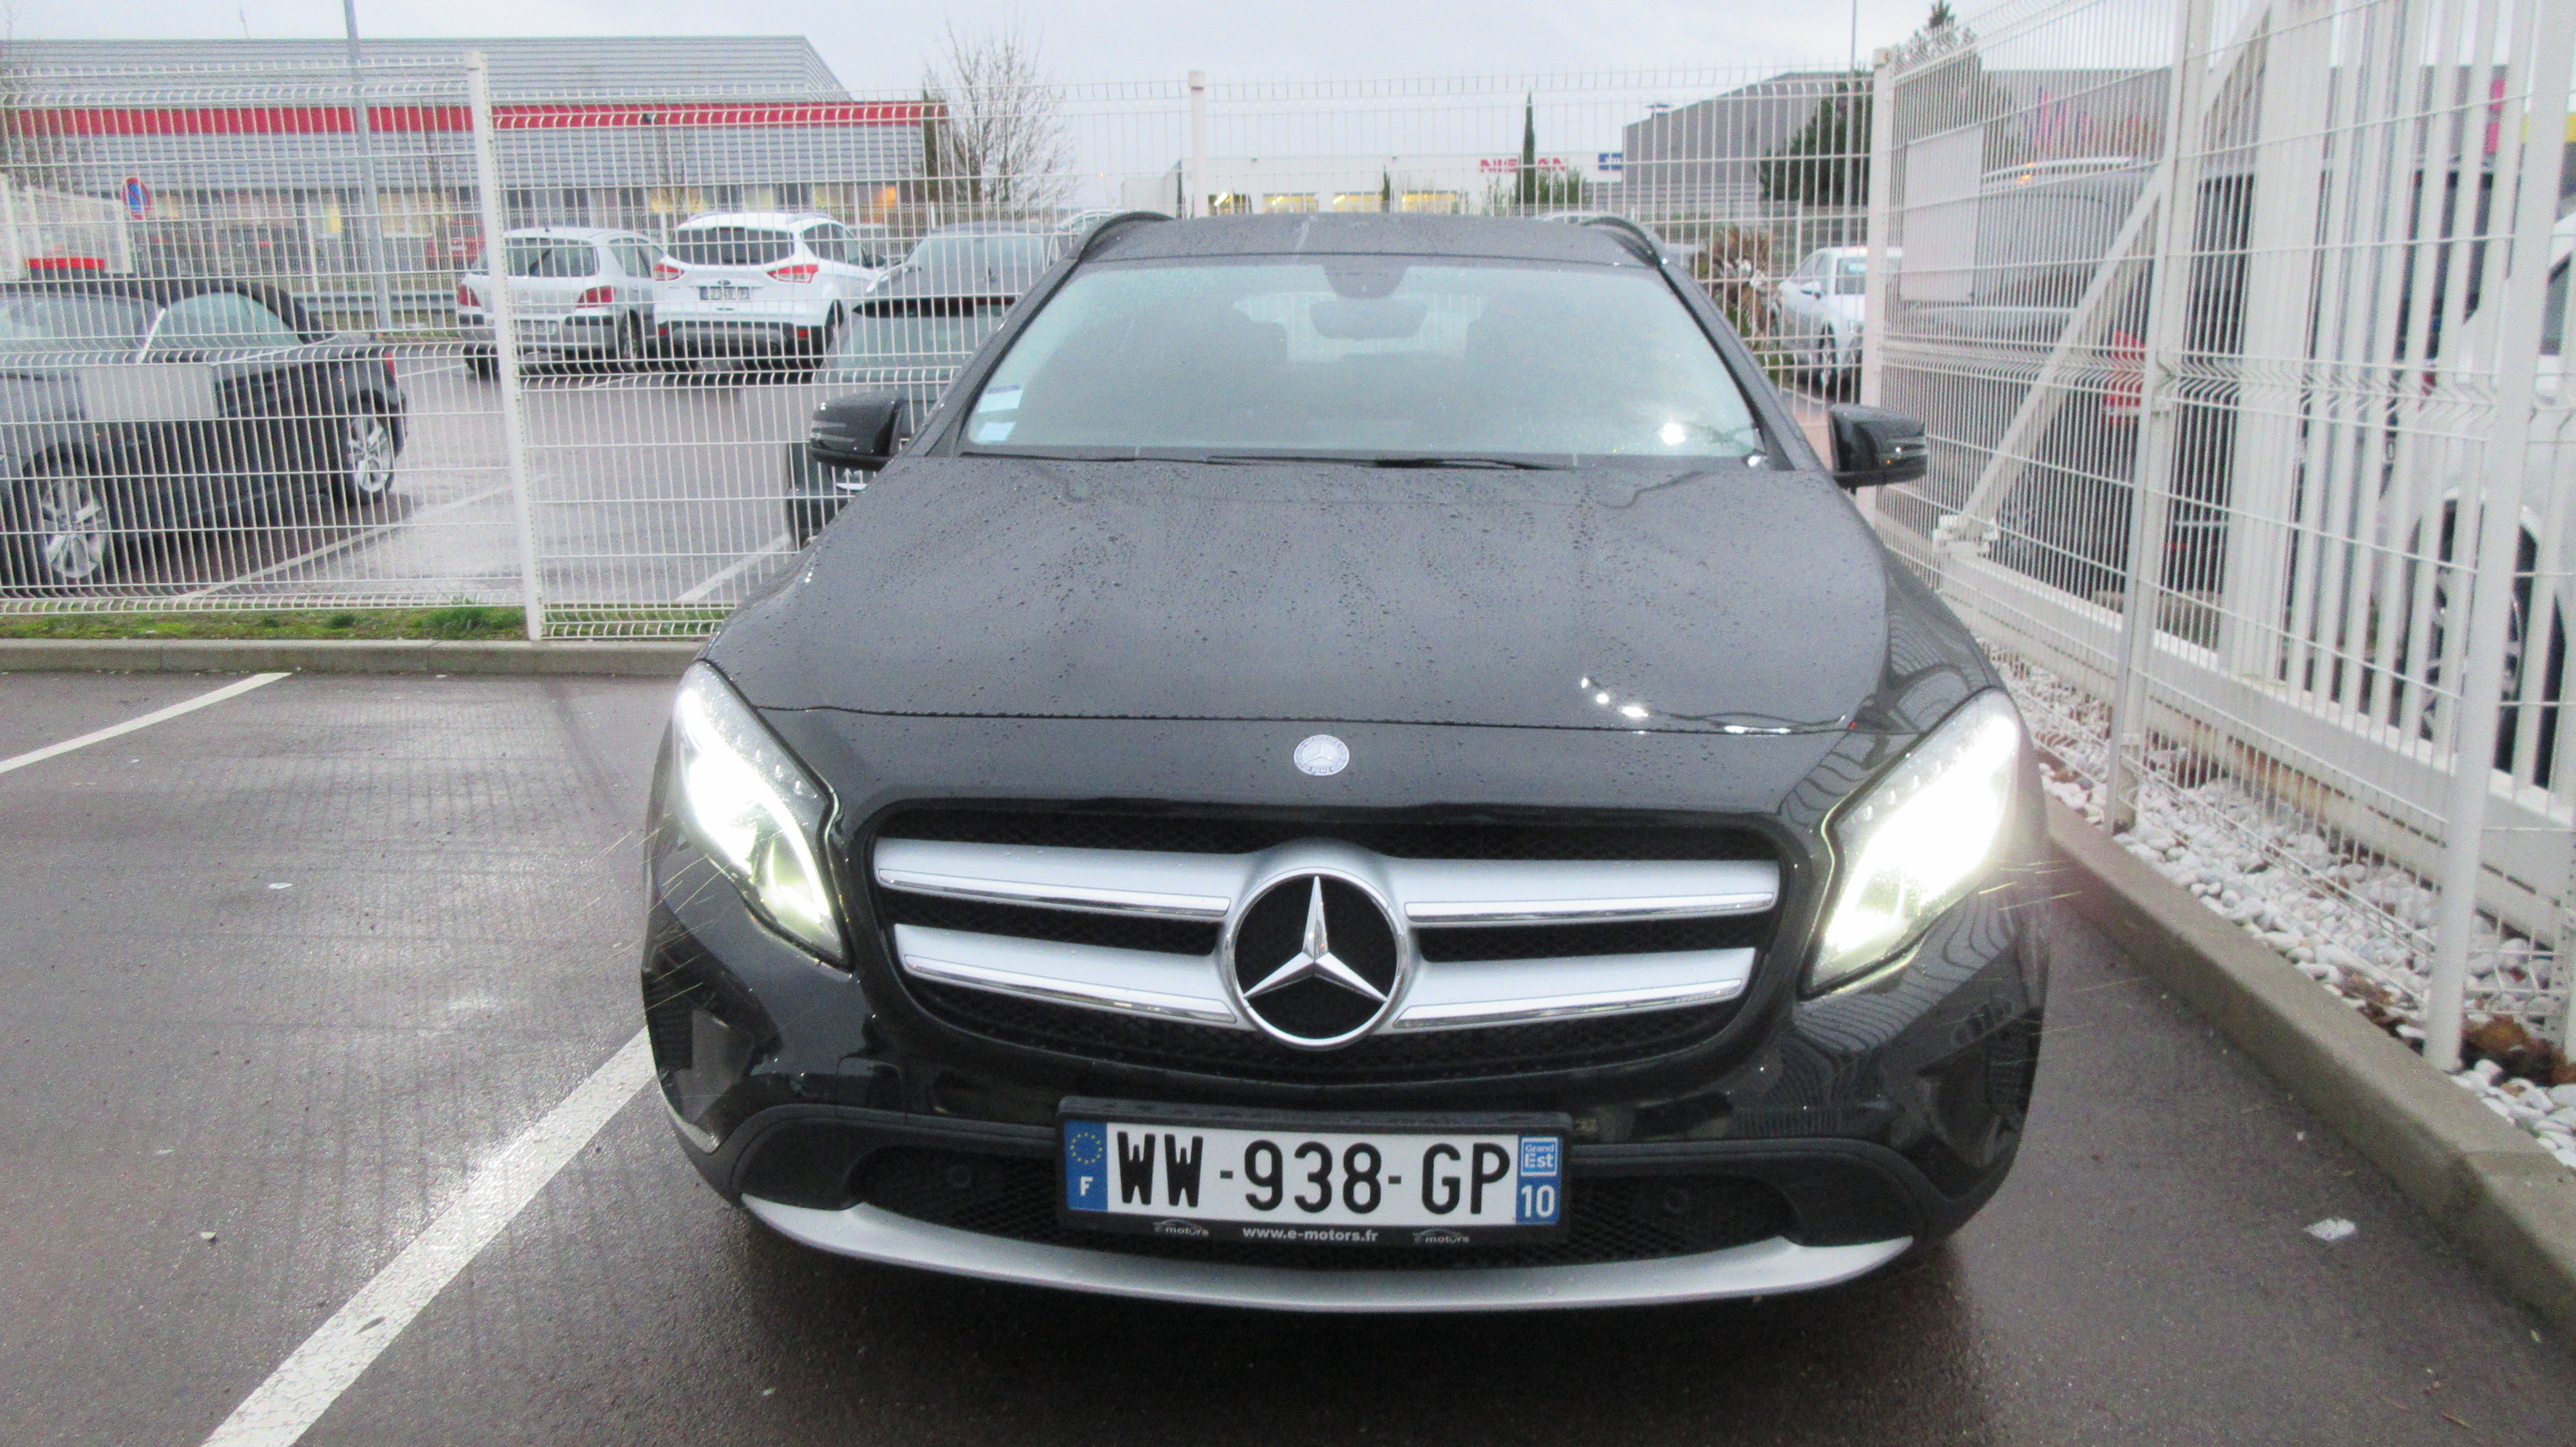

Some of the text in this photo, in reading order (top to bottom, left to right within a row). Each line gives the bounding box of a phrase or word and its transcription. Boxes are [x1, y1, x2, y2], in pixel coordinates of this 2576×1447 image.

[1480, 158, 1568, 172] NISAN
[1525, 1143, 1554, 1153] Grand
[1524, 1152, 1554, 1168] Est
[1117, 1130, 1511, 1215] WW-938-GP
[1080, 1176, 1093, 1196] F
[1521, 1184, 1555, 1217] 10
[1242, 1227, 1379, 1242] www.e-motors.fr
